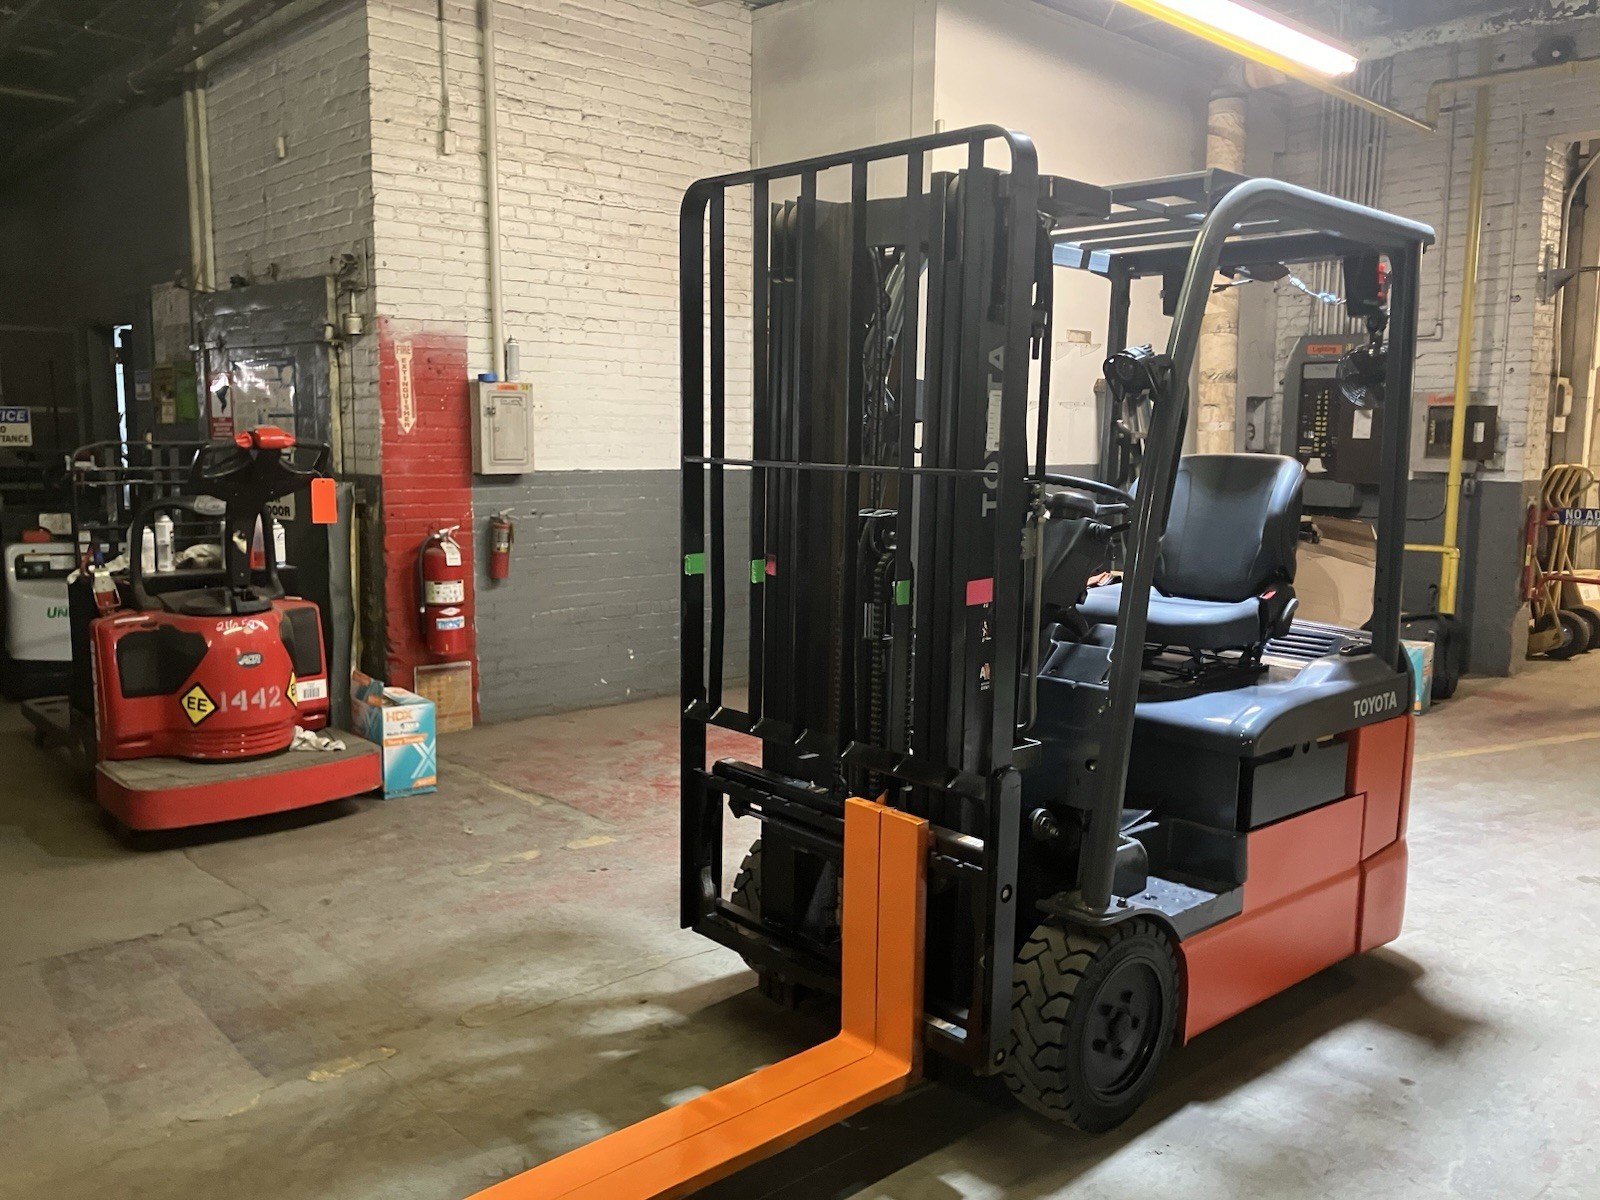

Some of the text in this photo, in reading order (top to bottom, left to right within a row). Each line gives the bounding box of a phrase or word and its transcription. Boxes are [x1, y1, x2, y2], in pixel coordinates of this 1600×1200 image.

[401, 357, 410, 428] EXTINGUISHER
[0, 410, 26, 421] ICE
[981, 345, 1004, 518] TOTA
[1565, 508, 1582, 519] NO
[187, 696, 208, 713] EE
[220, 685, 281, 713] 1442
[1353, 691, 1398, 718] TOYOTA
[386, 710, 413, 722] HDX
